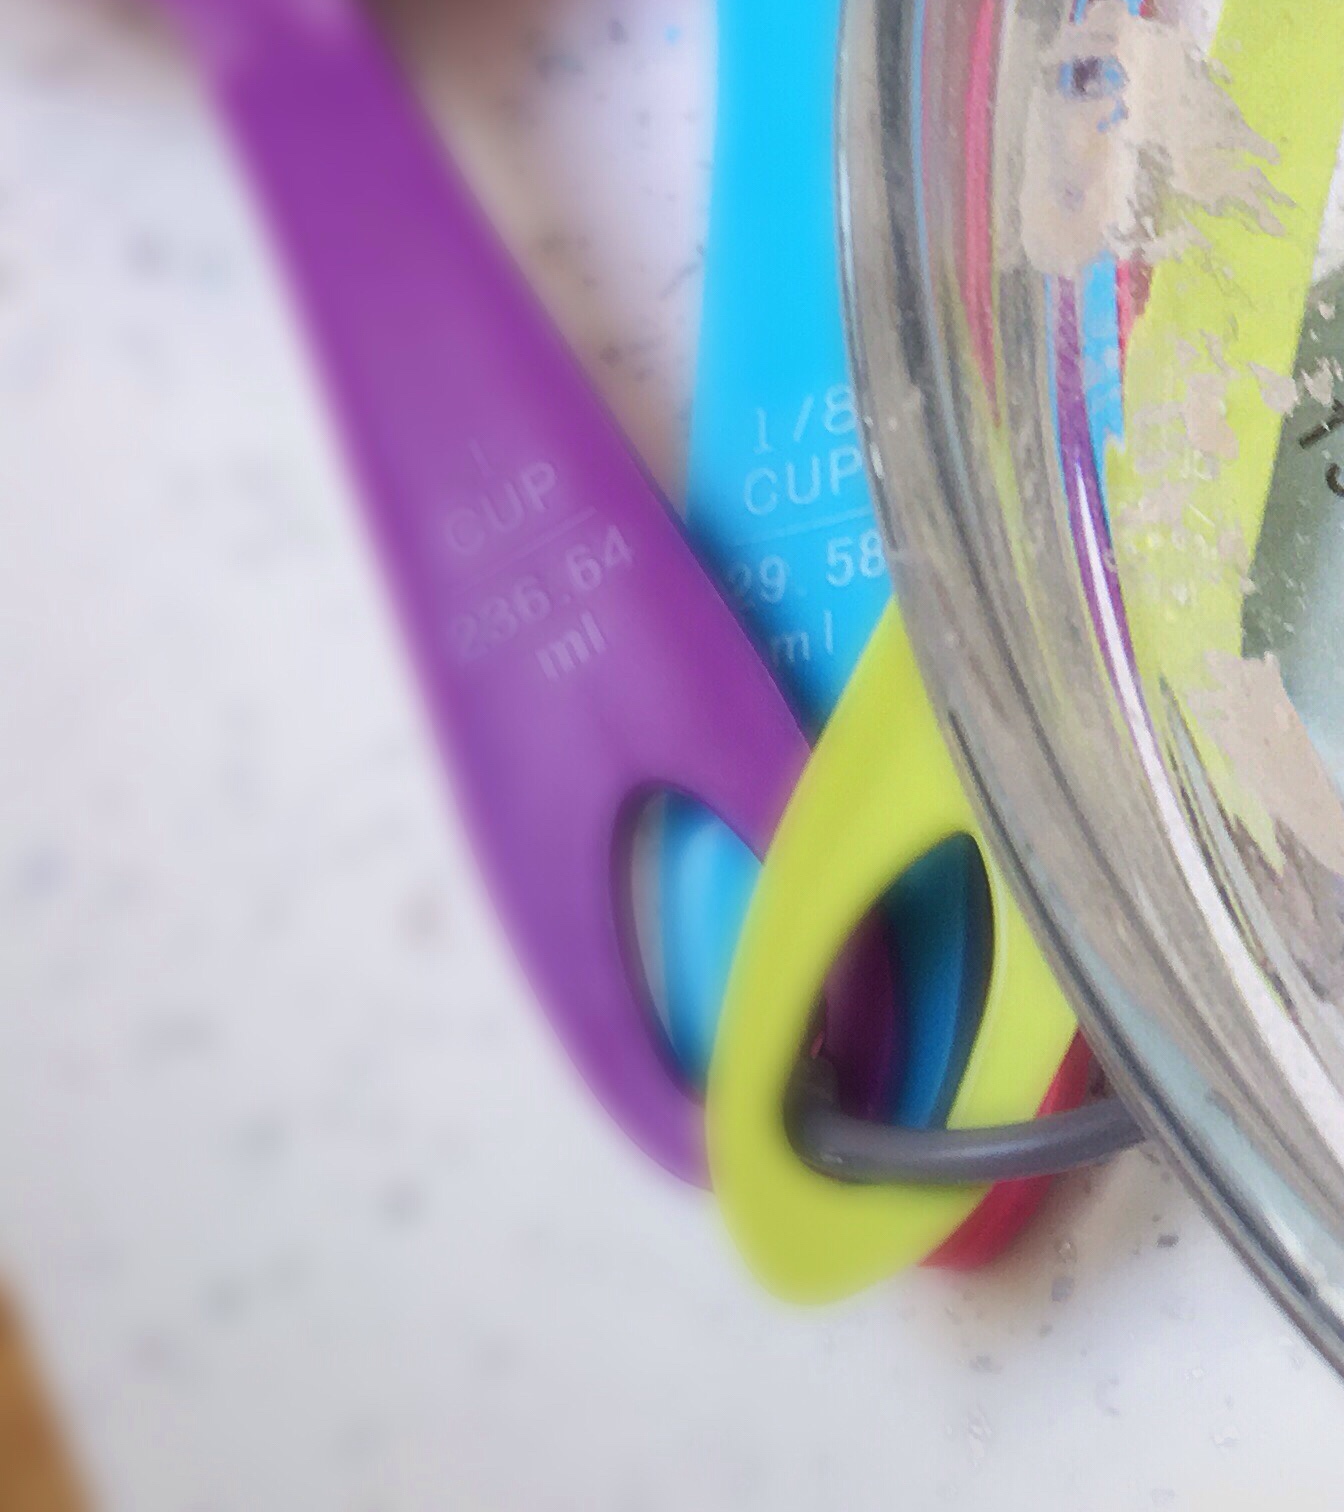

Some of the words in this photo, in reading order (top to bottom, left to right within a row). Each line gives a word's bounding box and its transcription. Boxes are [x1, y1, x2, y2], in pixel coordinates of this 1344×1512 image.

[753, 384, 857, 454] 1/8
[443, 461, 557, 556] CUP
[742, 444, 863, 515] CUP
[446, 523, 634, 664] 236.64
[533, 608, 608, 682] ml
[768, 609, 834, 666] ml
